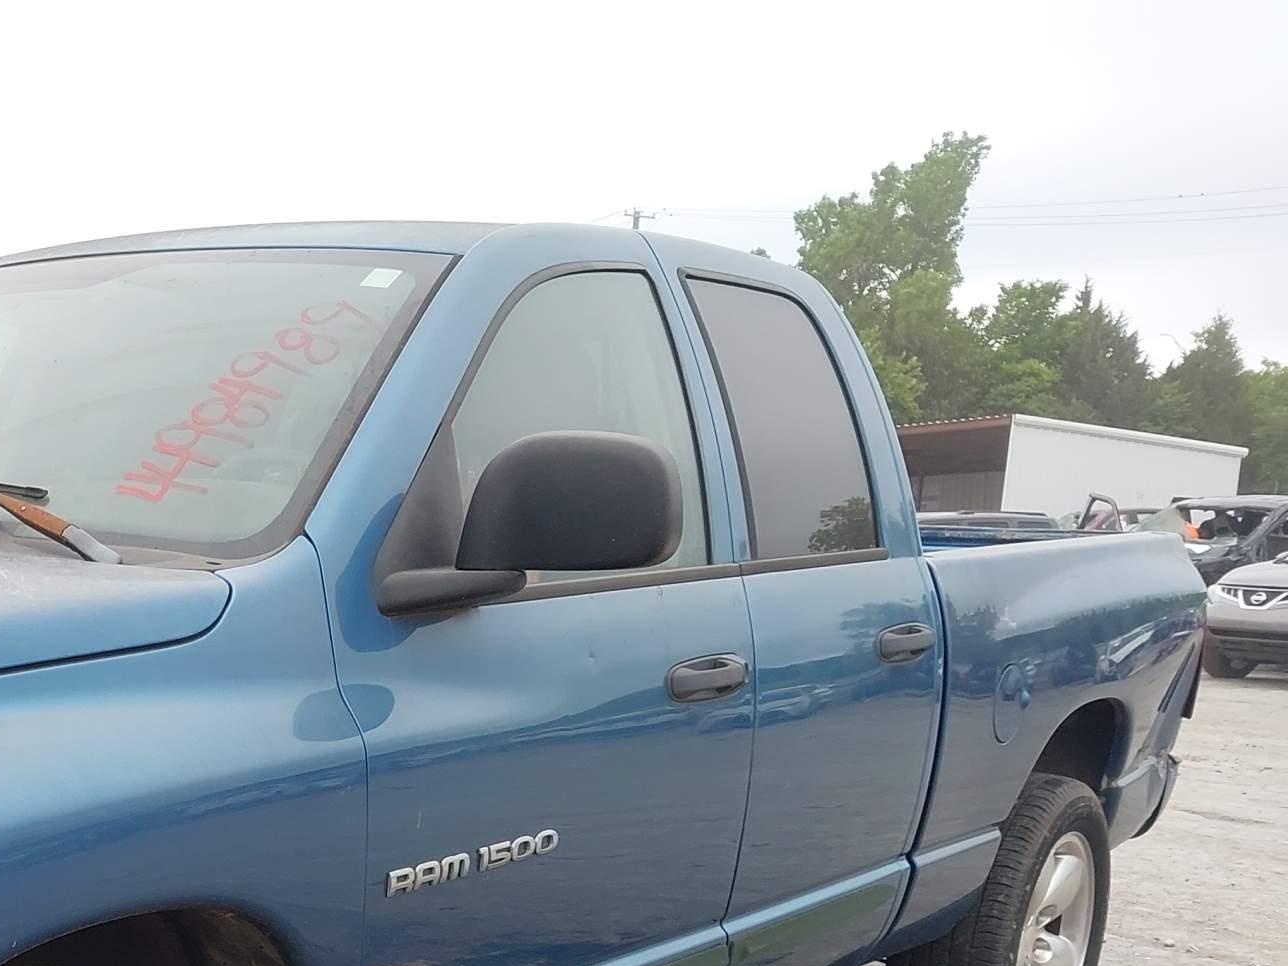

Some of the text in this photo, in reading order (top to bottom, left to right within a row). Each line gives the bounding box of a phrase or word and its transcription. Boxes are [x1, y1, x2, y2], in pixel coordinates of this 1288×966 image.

[115, 300, 378, 503] 44984989
[386, 829, 559, 897] RAM 1500
